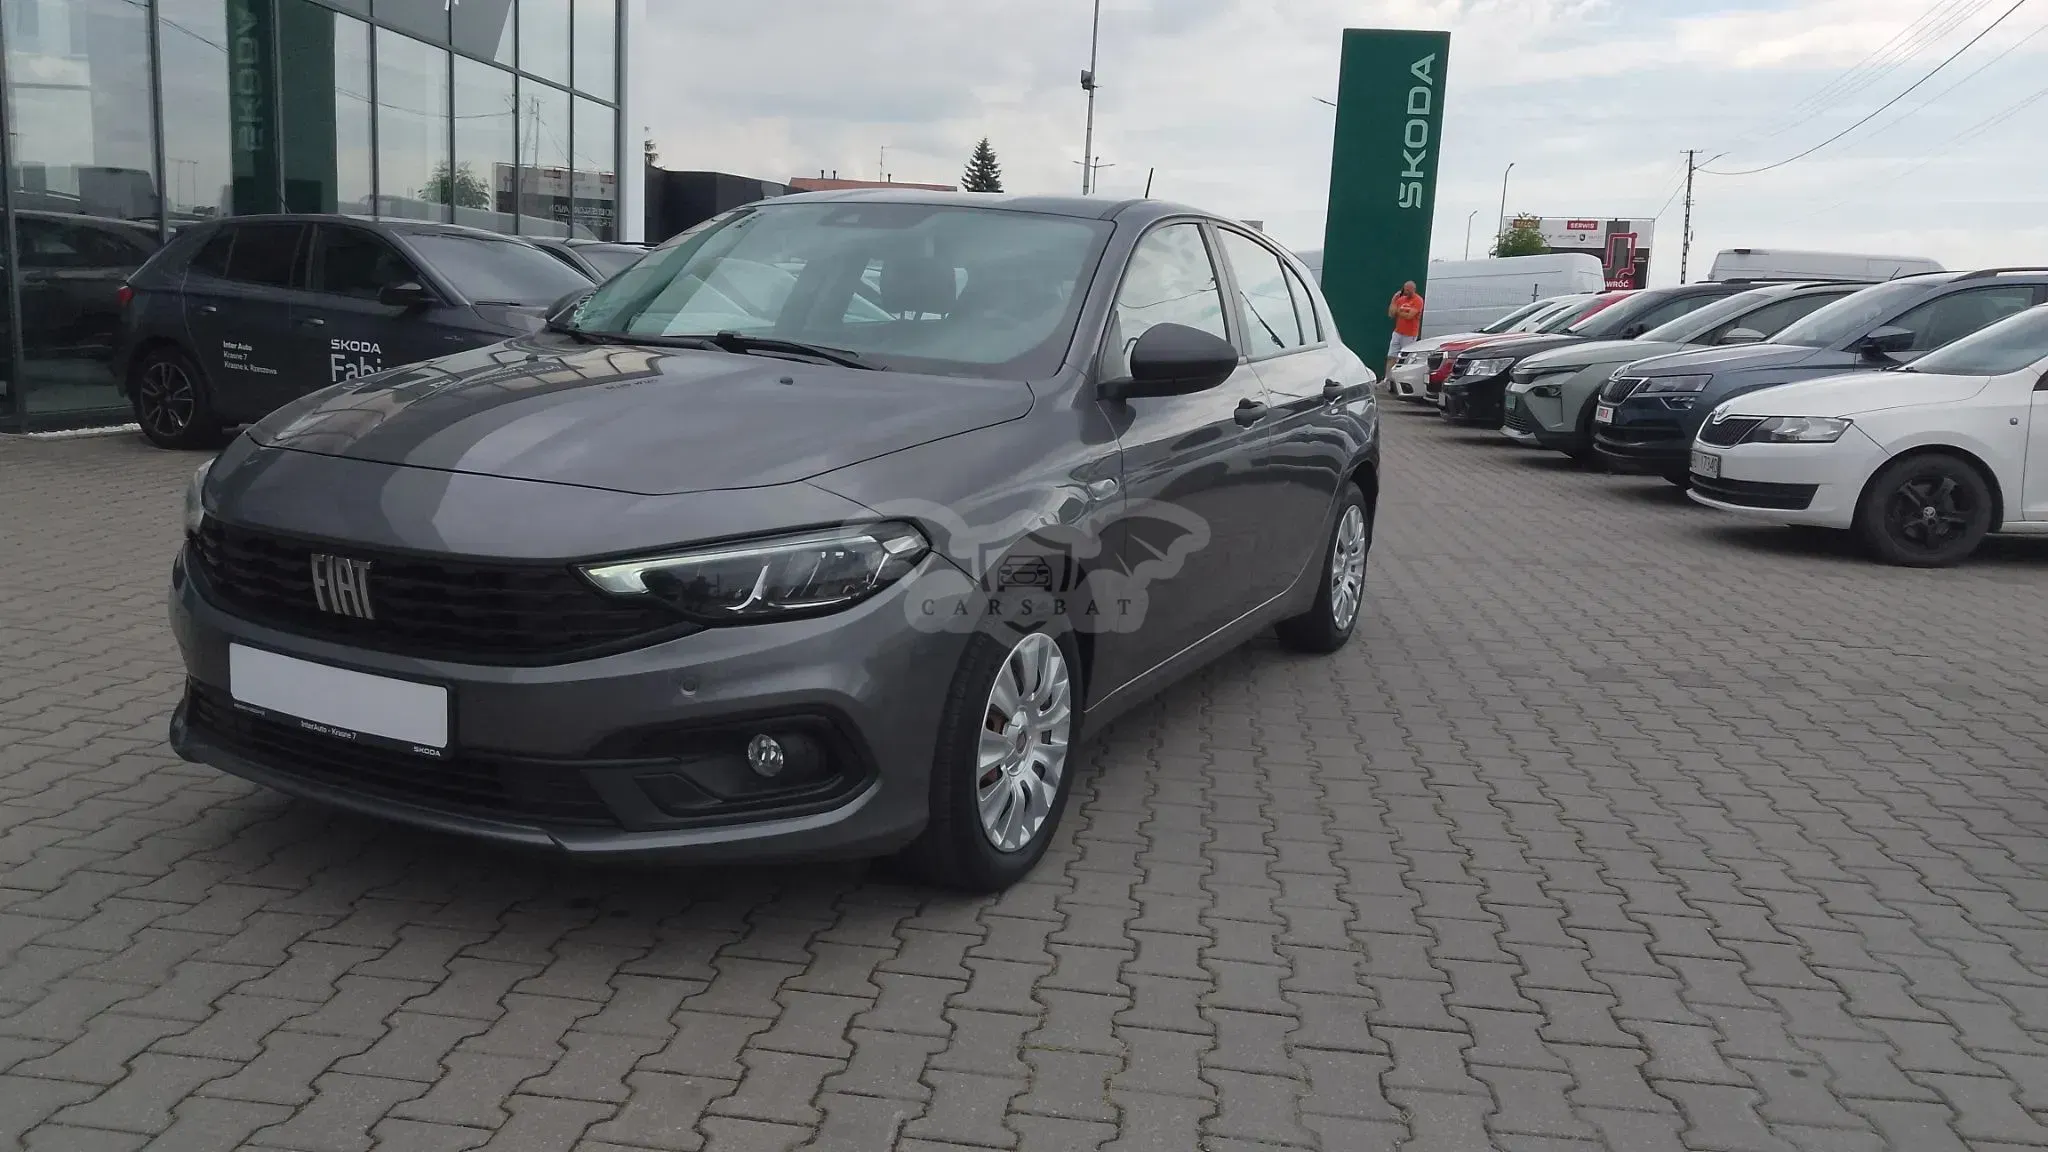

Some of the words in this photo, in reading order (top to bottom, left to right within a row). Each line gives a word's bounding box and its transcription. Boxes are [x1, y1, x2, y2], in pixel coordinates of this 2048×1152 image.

[223, 340, 237, 349] Inter
[237, 342, 253, 351] Auto
[330, 353, 383, 382] Fabi
[310, 552, 376, 620] FIAT
